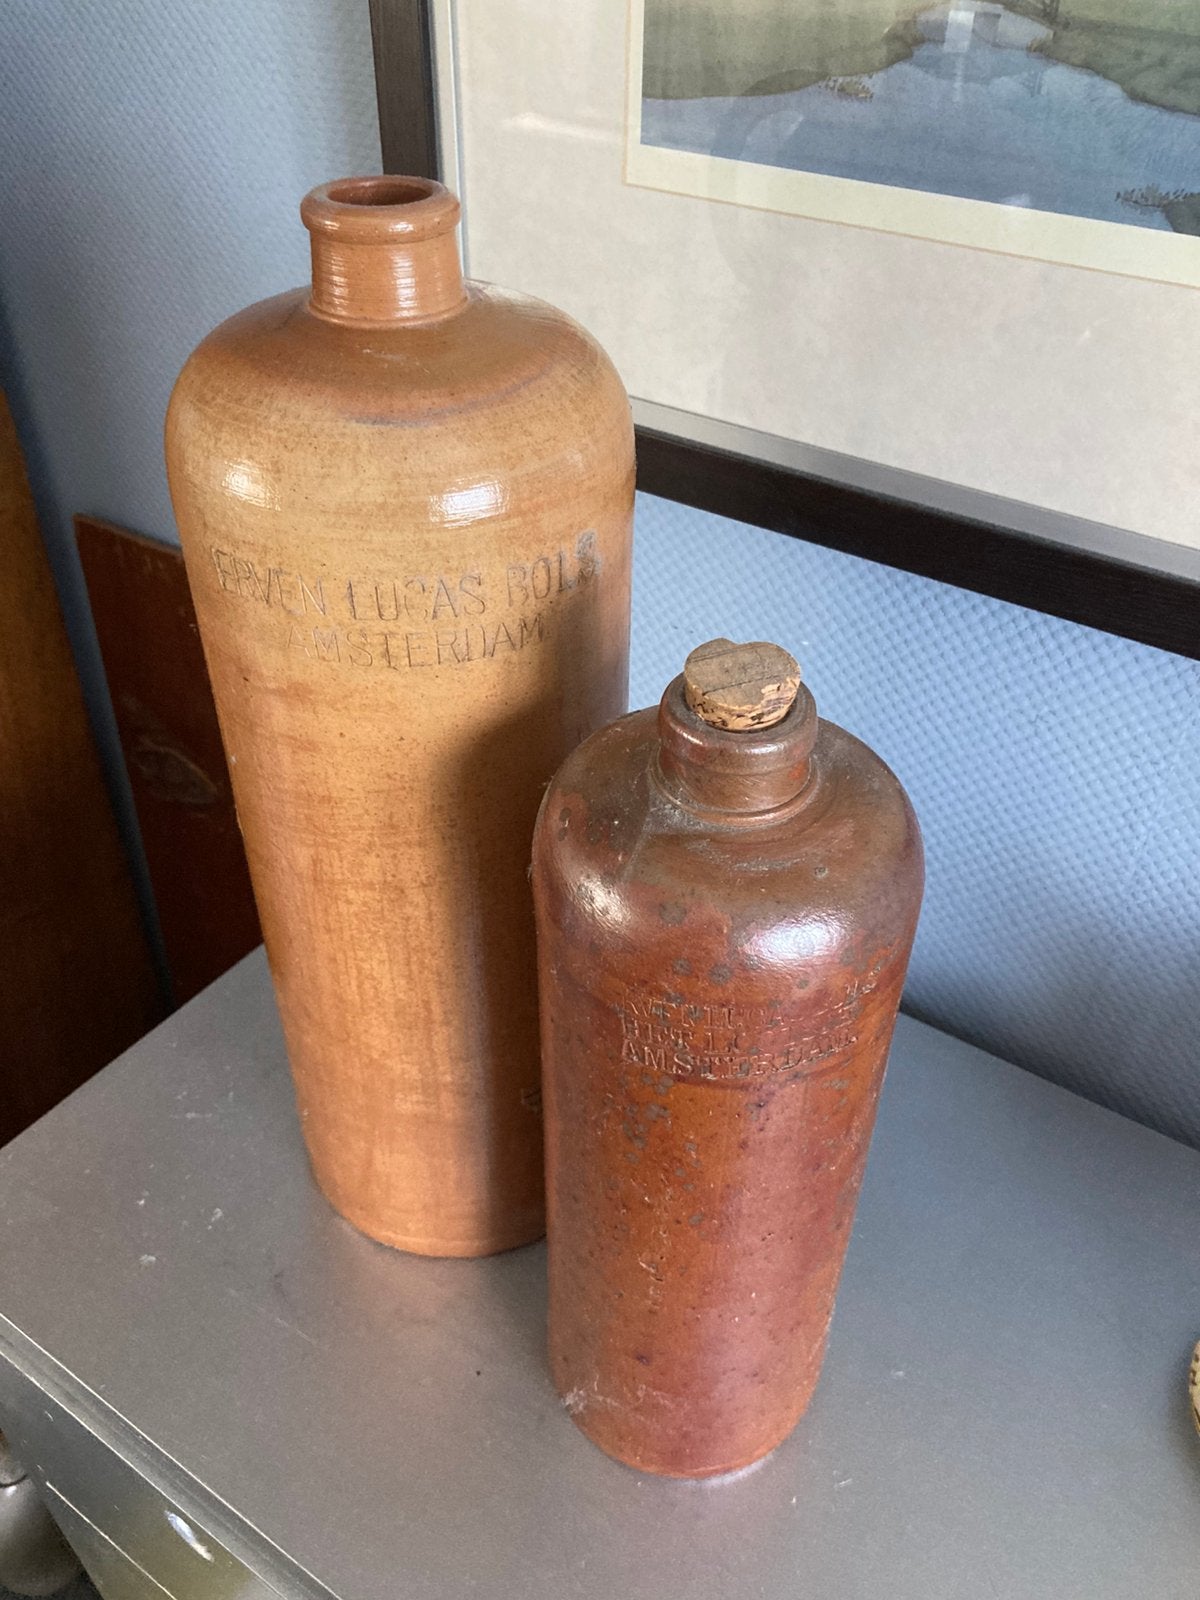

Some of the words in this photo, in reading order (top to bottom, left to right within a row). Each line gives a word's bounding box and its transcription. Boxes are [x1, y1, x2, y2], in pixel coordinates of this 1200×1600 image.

[210, 547, 327, 616] ERVEN
[346, 572, 487, 621] LUCAS
[286, 613, 546, 670] AMSTERDAM
[621, 1030, 859, 1080] AMSTERDAM
